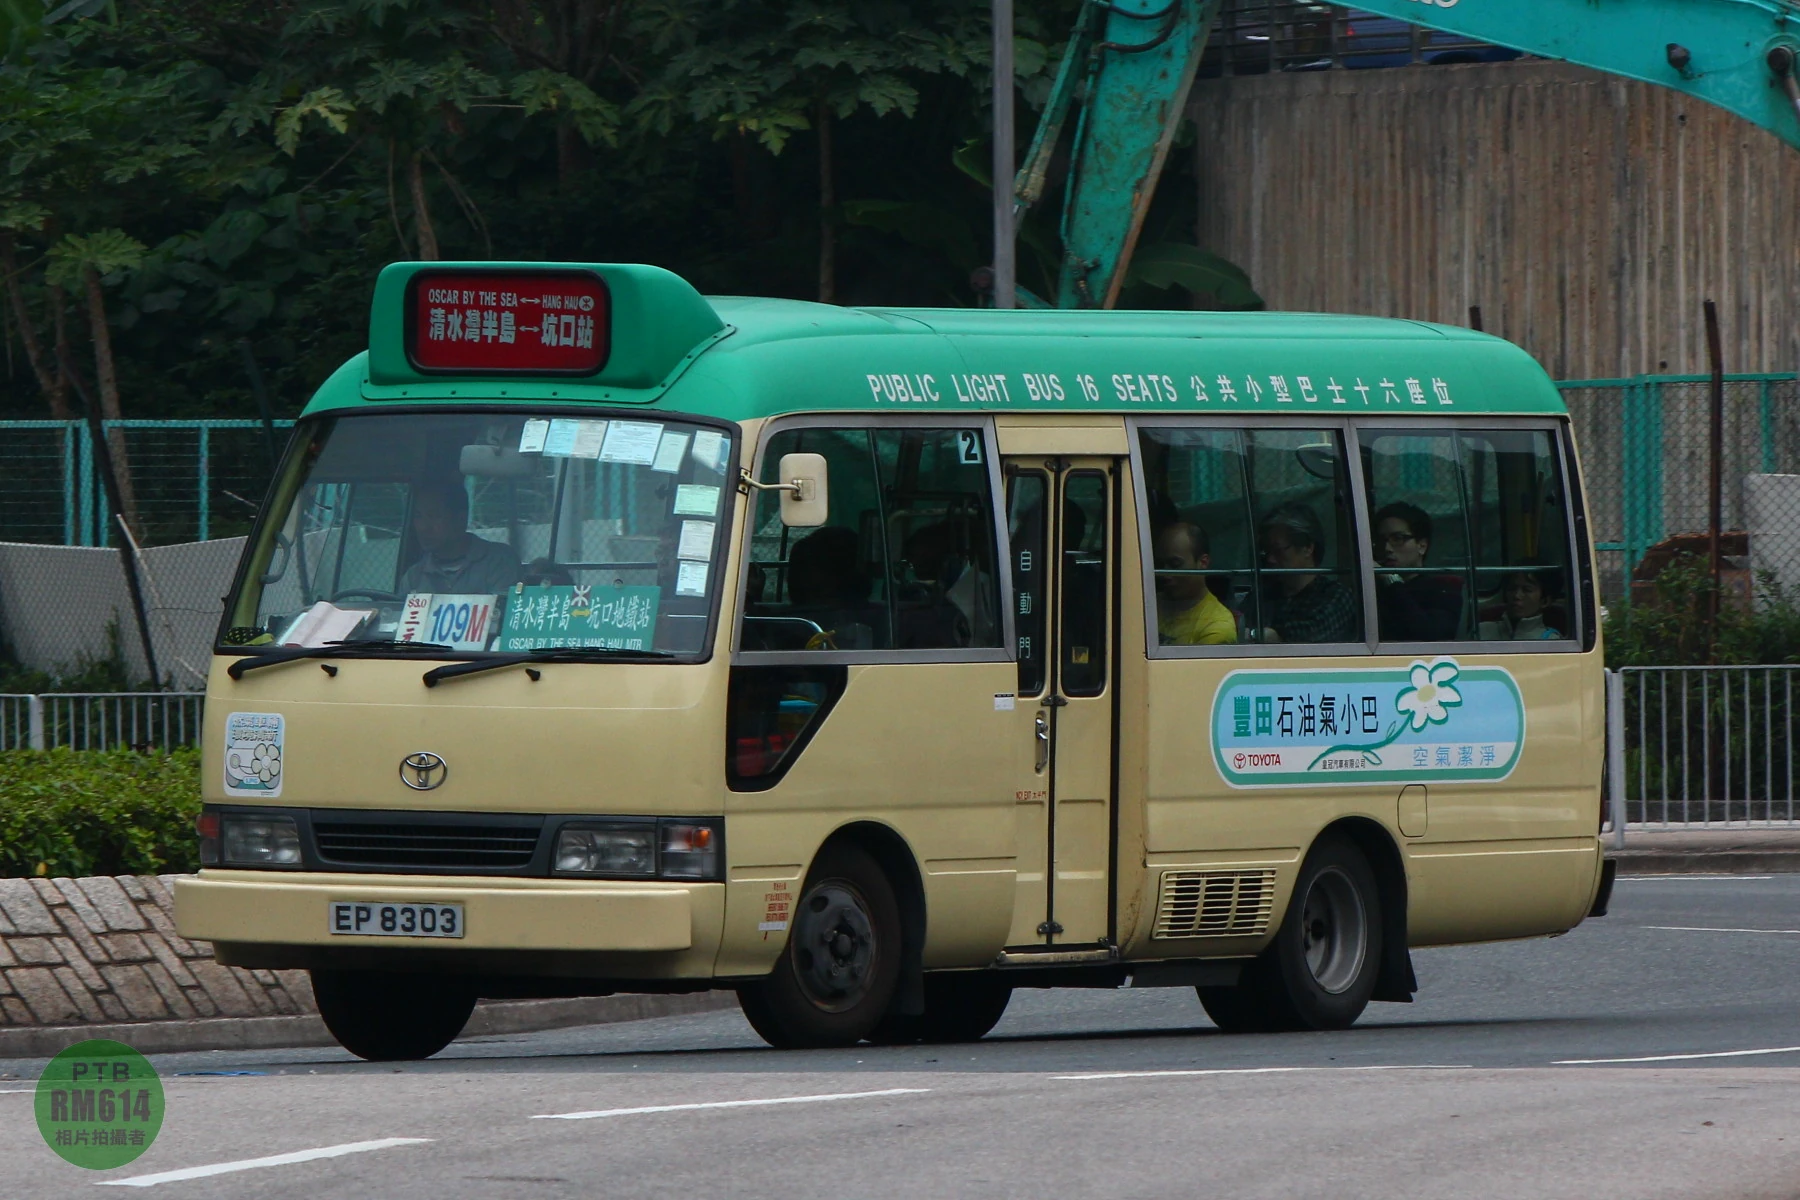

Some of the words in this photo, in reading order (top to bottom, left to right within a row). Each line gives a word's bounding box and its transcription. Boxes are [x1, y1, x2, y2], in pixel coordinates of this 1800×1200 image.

[428, 288, 459, 305] OSCAR
[462, 290, 476, 305] BY
[479, 291, 497, 306] THE
[500, 292, 519, 308] SEA
[542, 294, 562, 310] HANG
[564, 295, 579, 310] HAU
[429, 307, 517, 344] 清水灣半島
[541, 312, 594, 349] 坑口站
[866, 374, 939, 402] PUBLIC
[951, 374, 1010, 402] LIGHT
[1023, 373, 1065, 401] BUS
[1076, 374, 1100, 401] 16
[1112, 374, 1178, 402] SEATS
[1190, 374, 1453, 405] 公共小型巴士十六座位
[961, 430, 979, 462] 2
[509, 595, 571, 631] 清水灣半島
[1018, 549, 1033, 660] 自動門
[431, 603, 489, 642] 109M
[508, 638, 534, 650] OSCAR
[536, 638, 548, 649] BY
[550, 638, 564, 649] THE
[566, 638, 581, 649] SEA
[584, 639, 605, 648] HANG
[607, 639, 623, 649] HAU
[625, 639, 643, 650] MTR
[1248, 753, 1281, 767] TOYOTA
[1413, 745, 1495, 767] 空氣潔淨
[335, 905, 371, 931] EP
[380, 906, 456, 933] 8303
